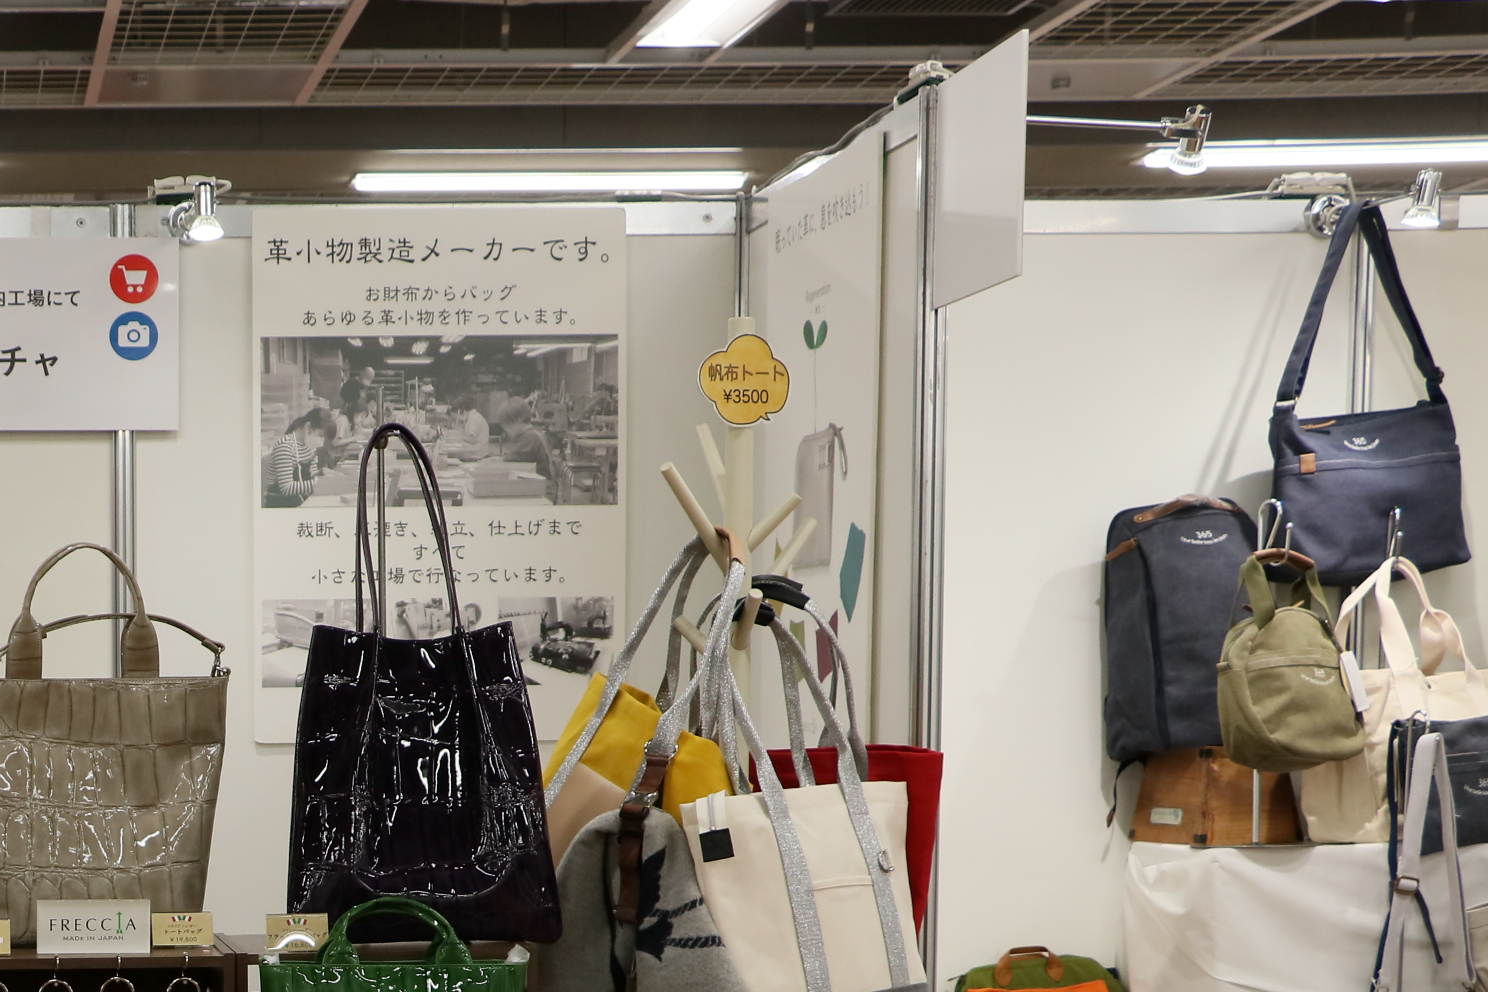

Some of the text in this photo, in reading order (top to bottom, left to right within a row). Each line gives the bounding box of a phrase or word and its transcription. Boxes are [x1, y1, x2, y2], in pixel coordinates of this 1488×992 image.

[263, 236, 611, 265] 革小物製造メーカーです。
[365, 284, 517, 302] お財布からバッグ
[302, 308, 578, 327] あらゆる革小物を作っています。
[708, 363, 785, 382] 帆布トート
[723, 389, 769, 404] ¥3500
[296, 519, 583, 539] 裁断、漉き、立、仕上げまで
[1195, 530, 1212, 539] 365
[49, 912, 137, 934] FRECCIA
